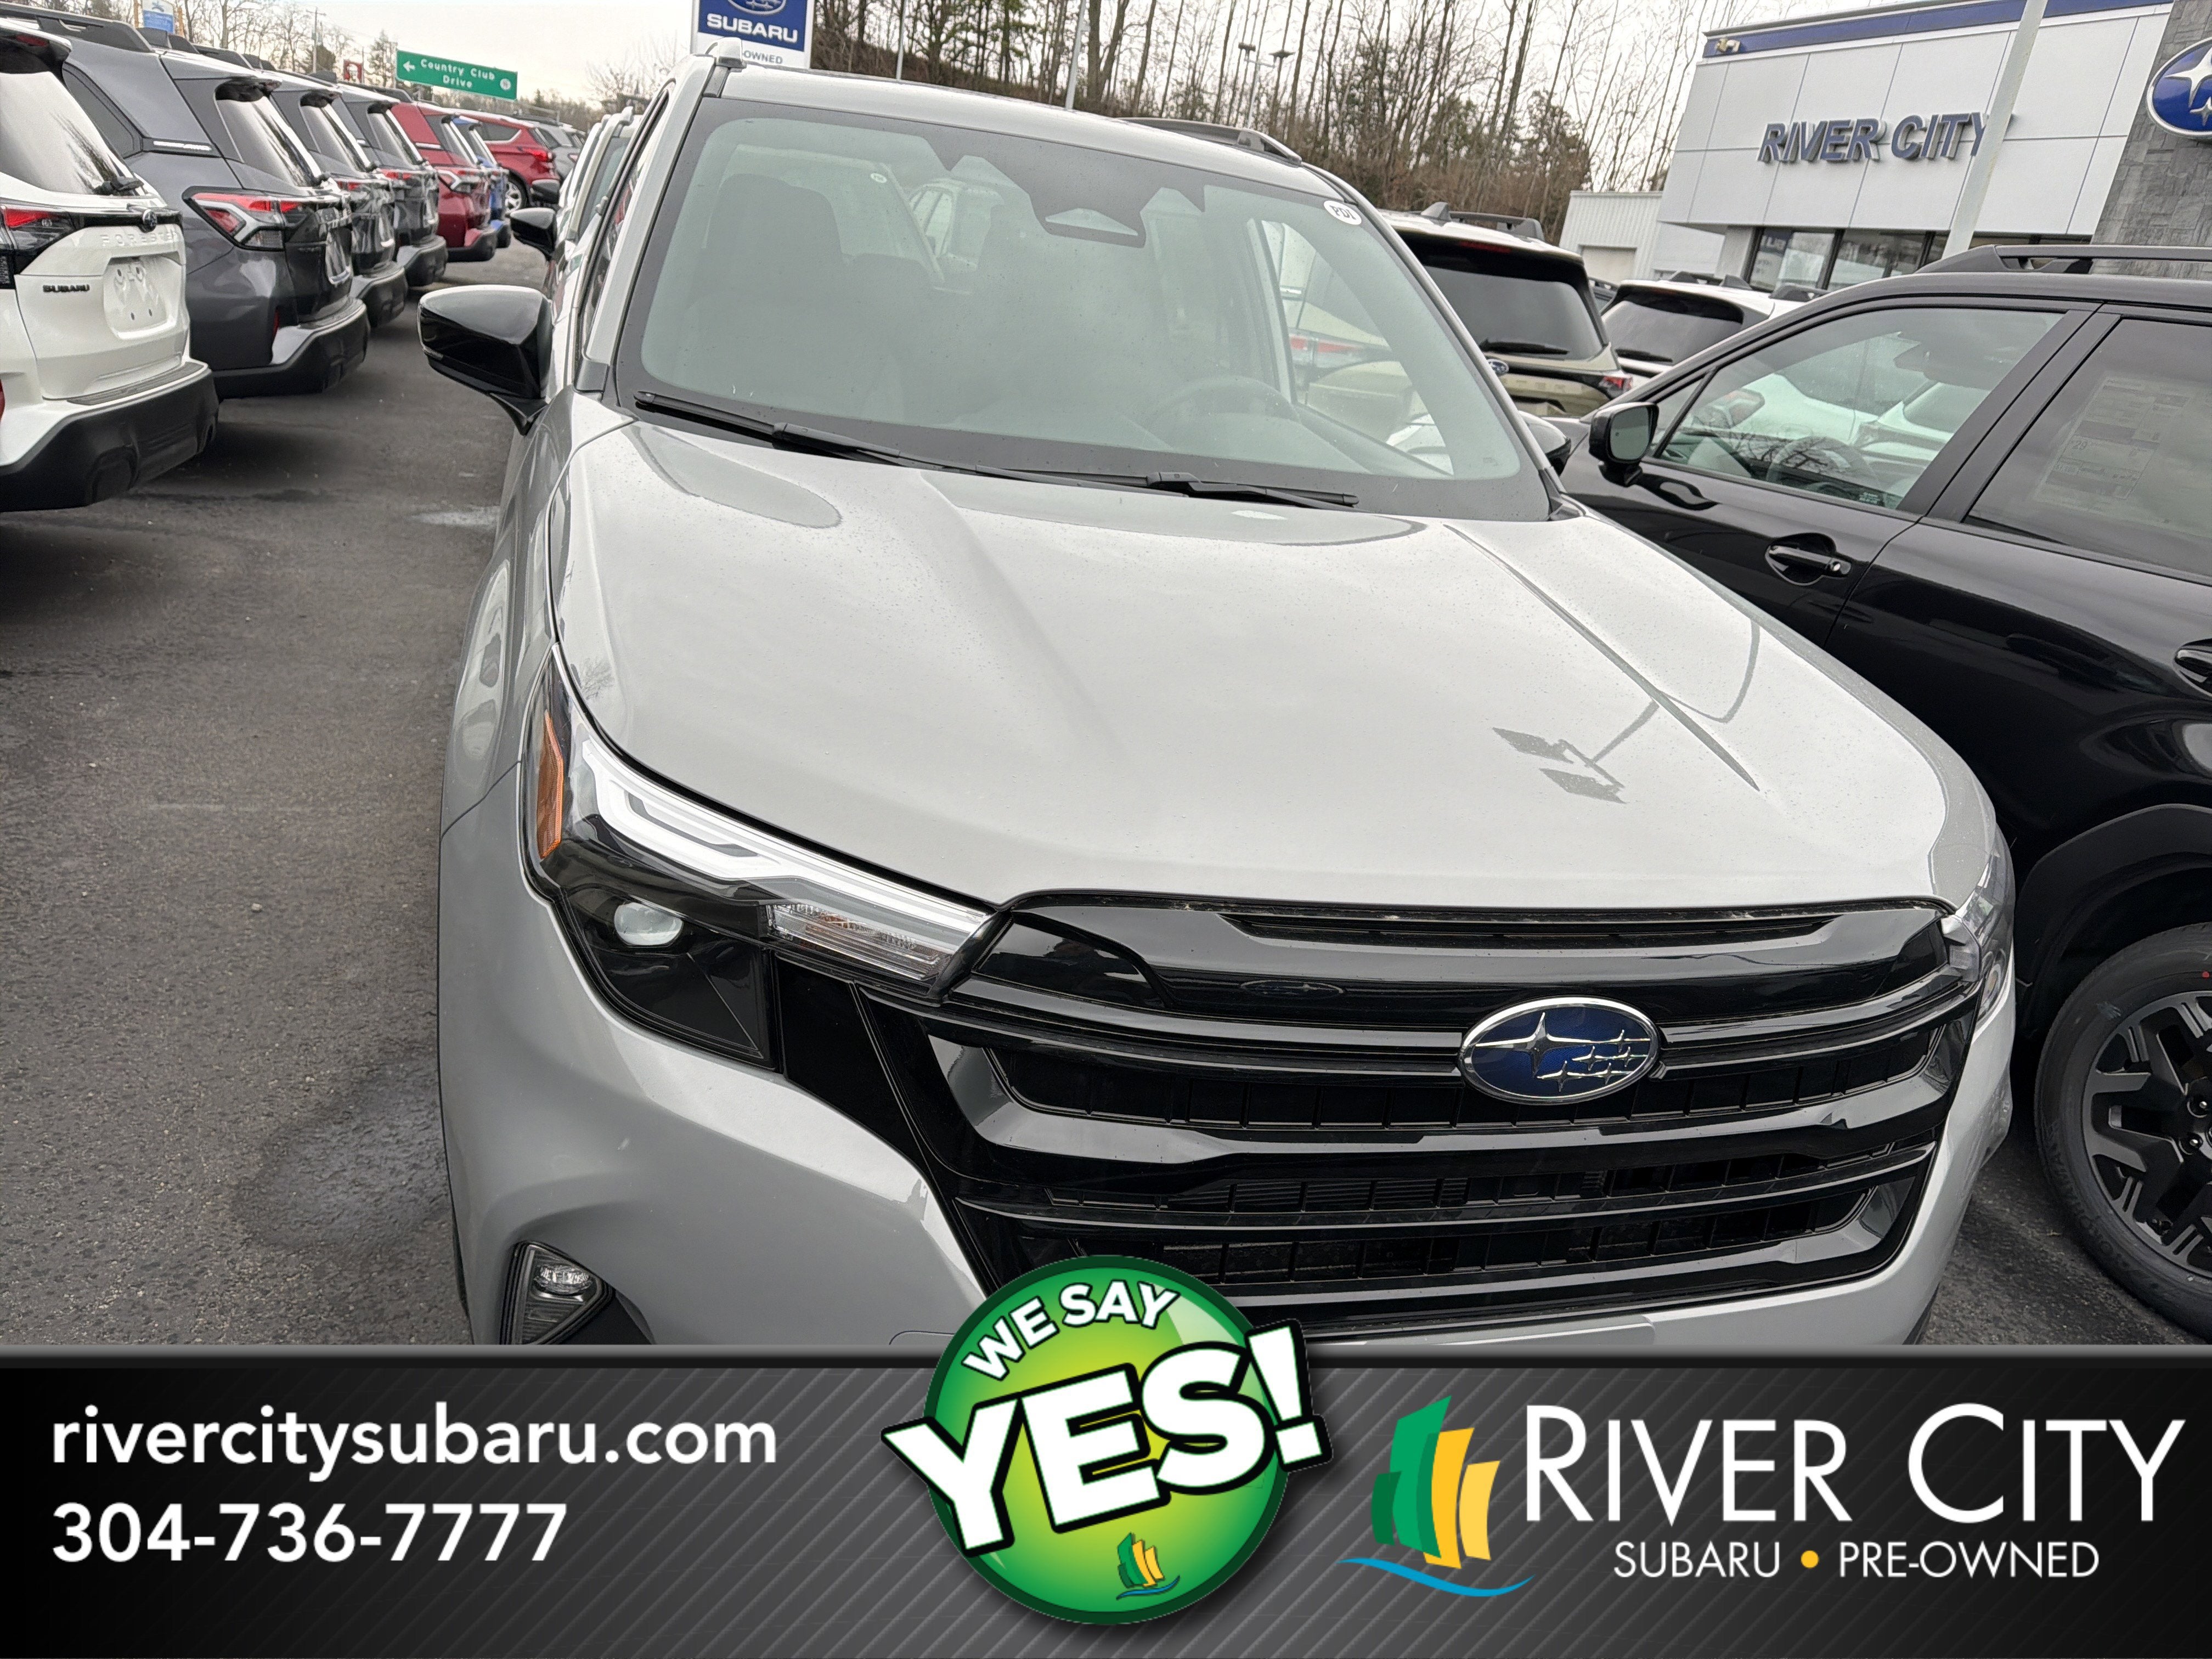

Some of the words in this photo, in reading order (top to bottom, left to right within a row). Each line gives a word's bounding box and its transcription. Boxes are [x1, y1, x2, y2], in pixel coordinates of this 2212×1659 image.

[707, 13, 798, 43] SUBARU
[420, 58, 465, 76] Country
[470, 67, 495, 80] Club
[442, 75, 473, 88] Drive
[1757, 118, 1883, 162] RIVER
[1891, 112, 1990, 160] CITY
[1329, 205, 1357, 220] PDI
[43, 284, 90, 293] SUBARU
